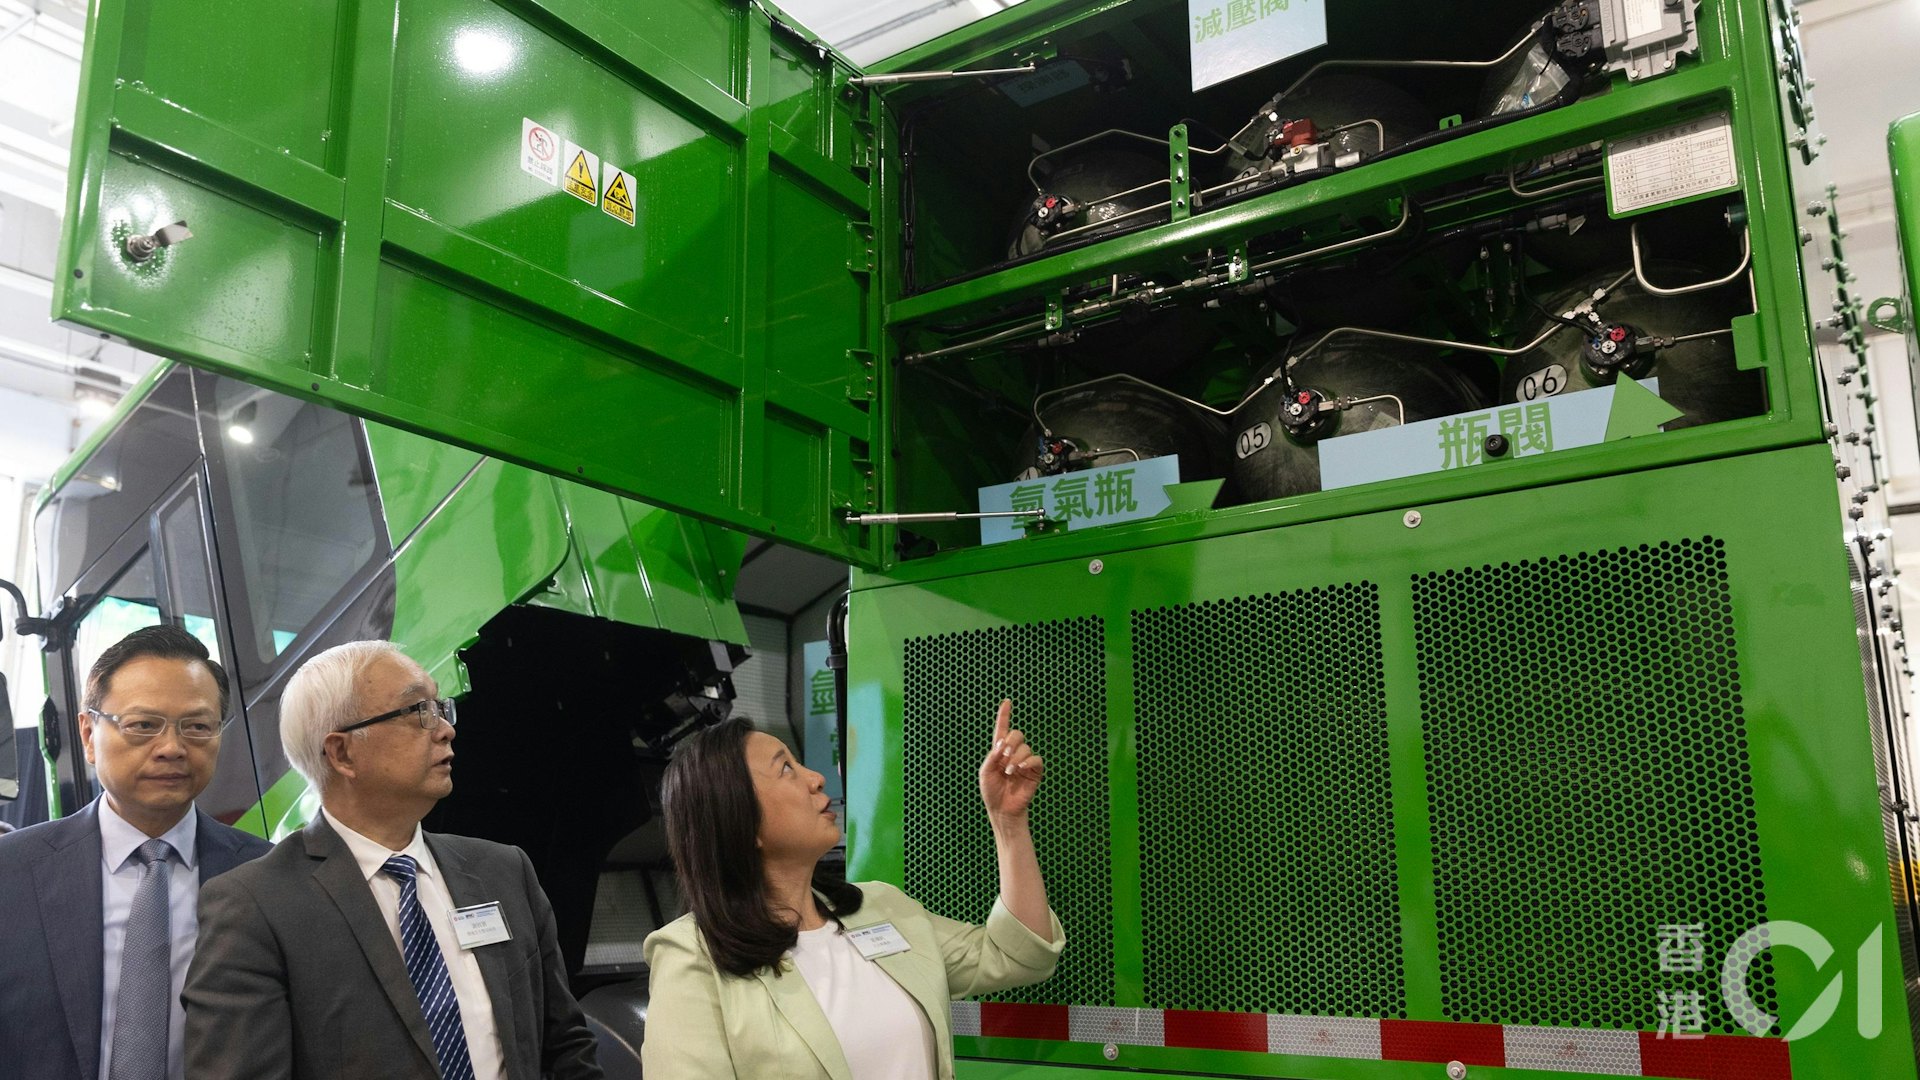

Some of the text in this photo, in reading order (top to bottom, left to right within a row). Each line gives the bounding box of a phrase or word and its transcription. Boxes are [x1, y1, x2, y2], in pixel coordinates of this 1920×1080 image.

[1521, 367, 1560, 401] 06
[1239, 425, 1265, 455] 05
[1437, 401, 1554, 471] 瓶閥
